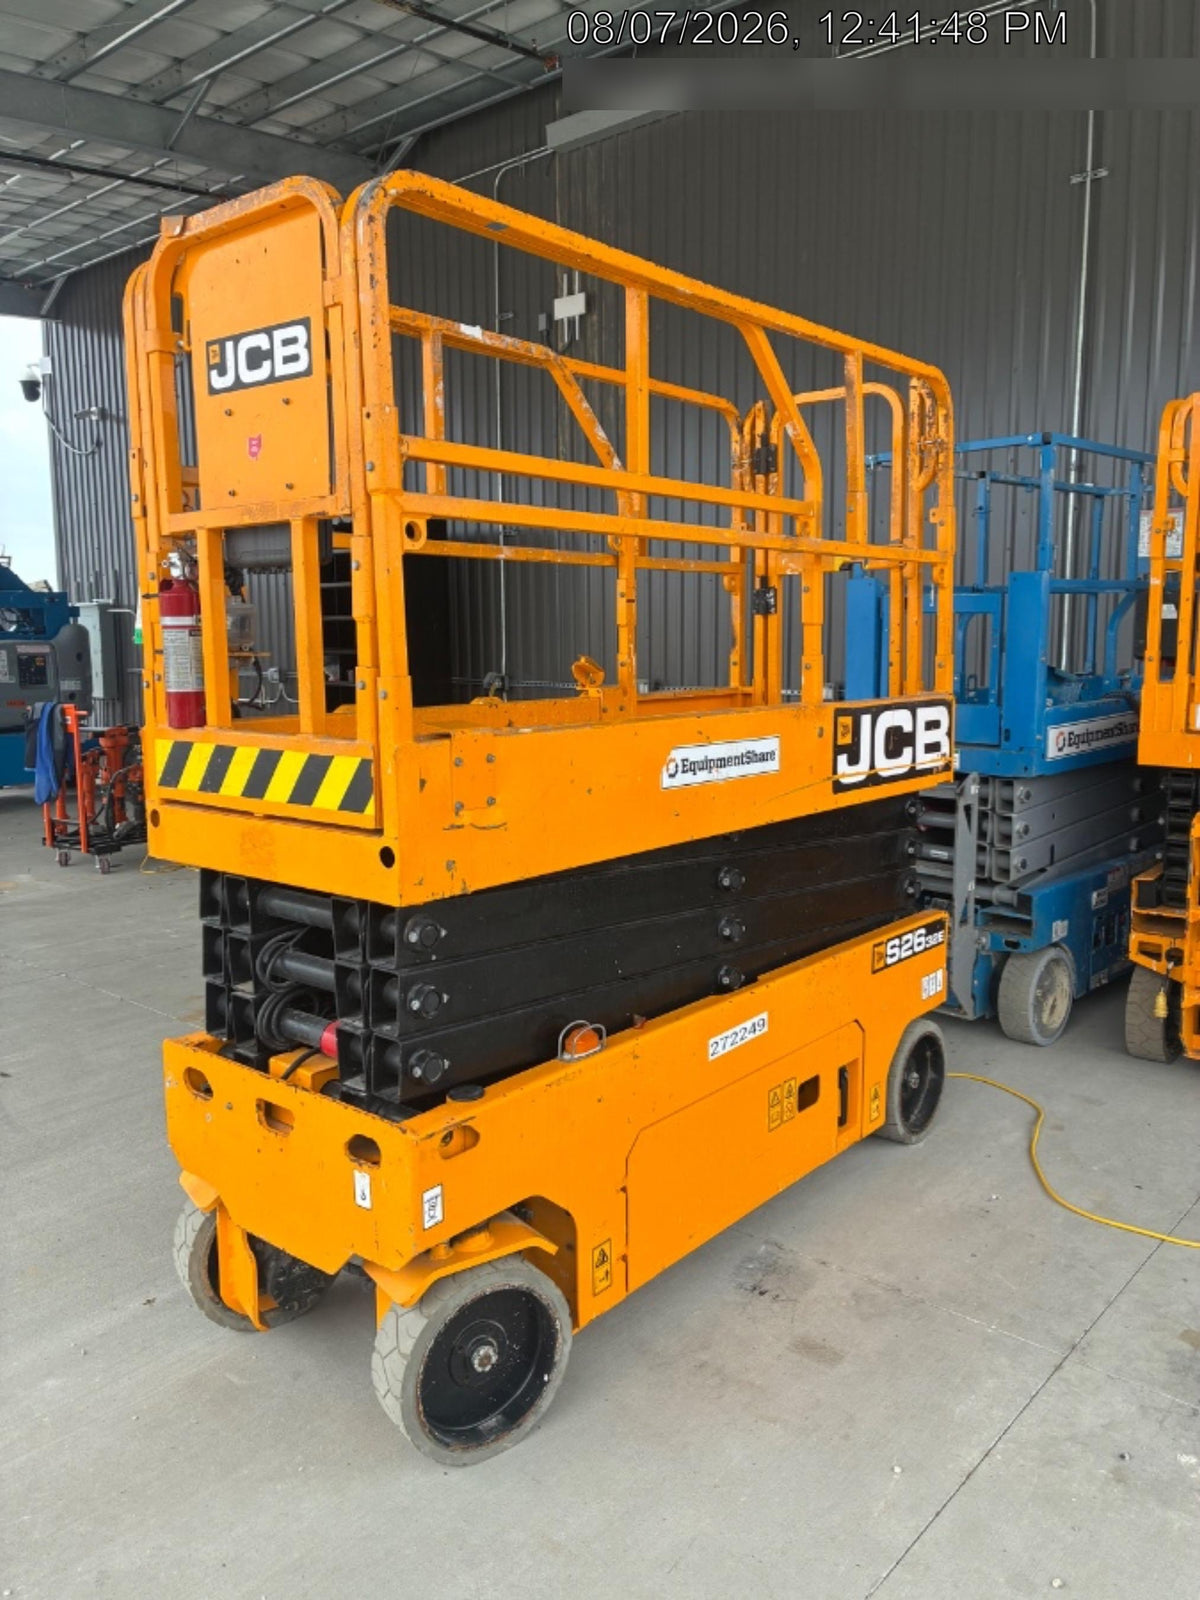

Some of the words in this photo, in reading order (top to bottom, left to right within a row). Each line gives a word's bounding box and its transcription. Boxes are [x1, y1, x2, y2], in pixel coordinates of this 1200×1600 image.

[210, 325, 310, 390] JCB
[681, 747, 776, 777] EquipmentShare
[836, 705, 950, 785] JCB
[710, 1017, 766, 1057] 272249
